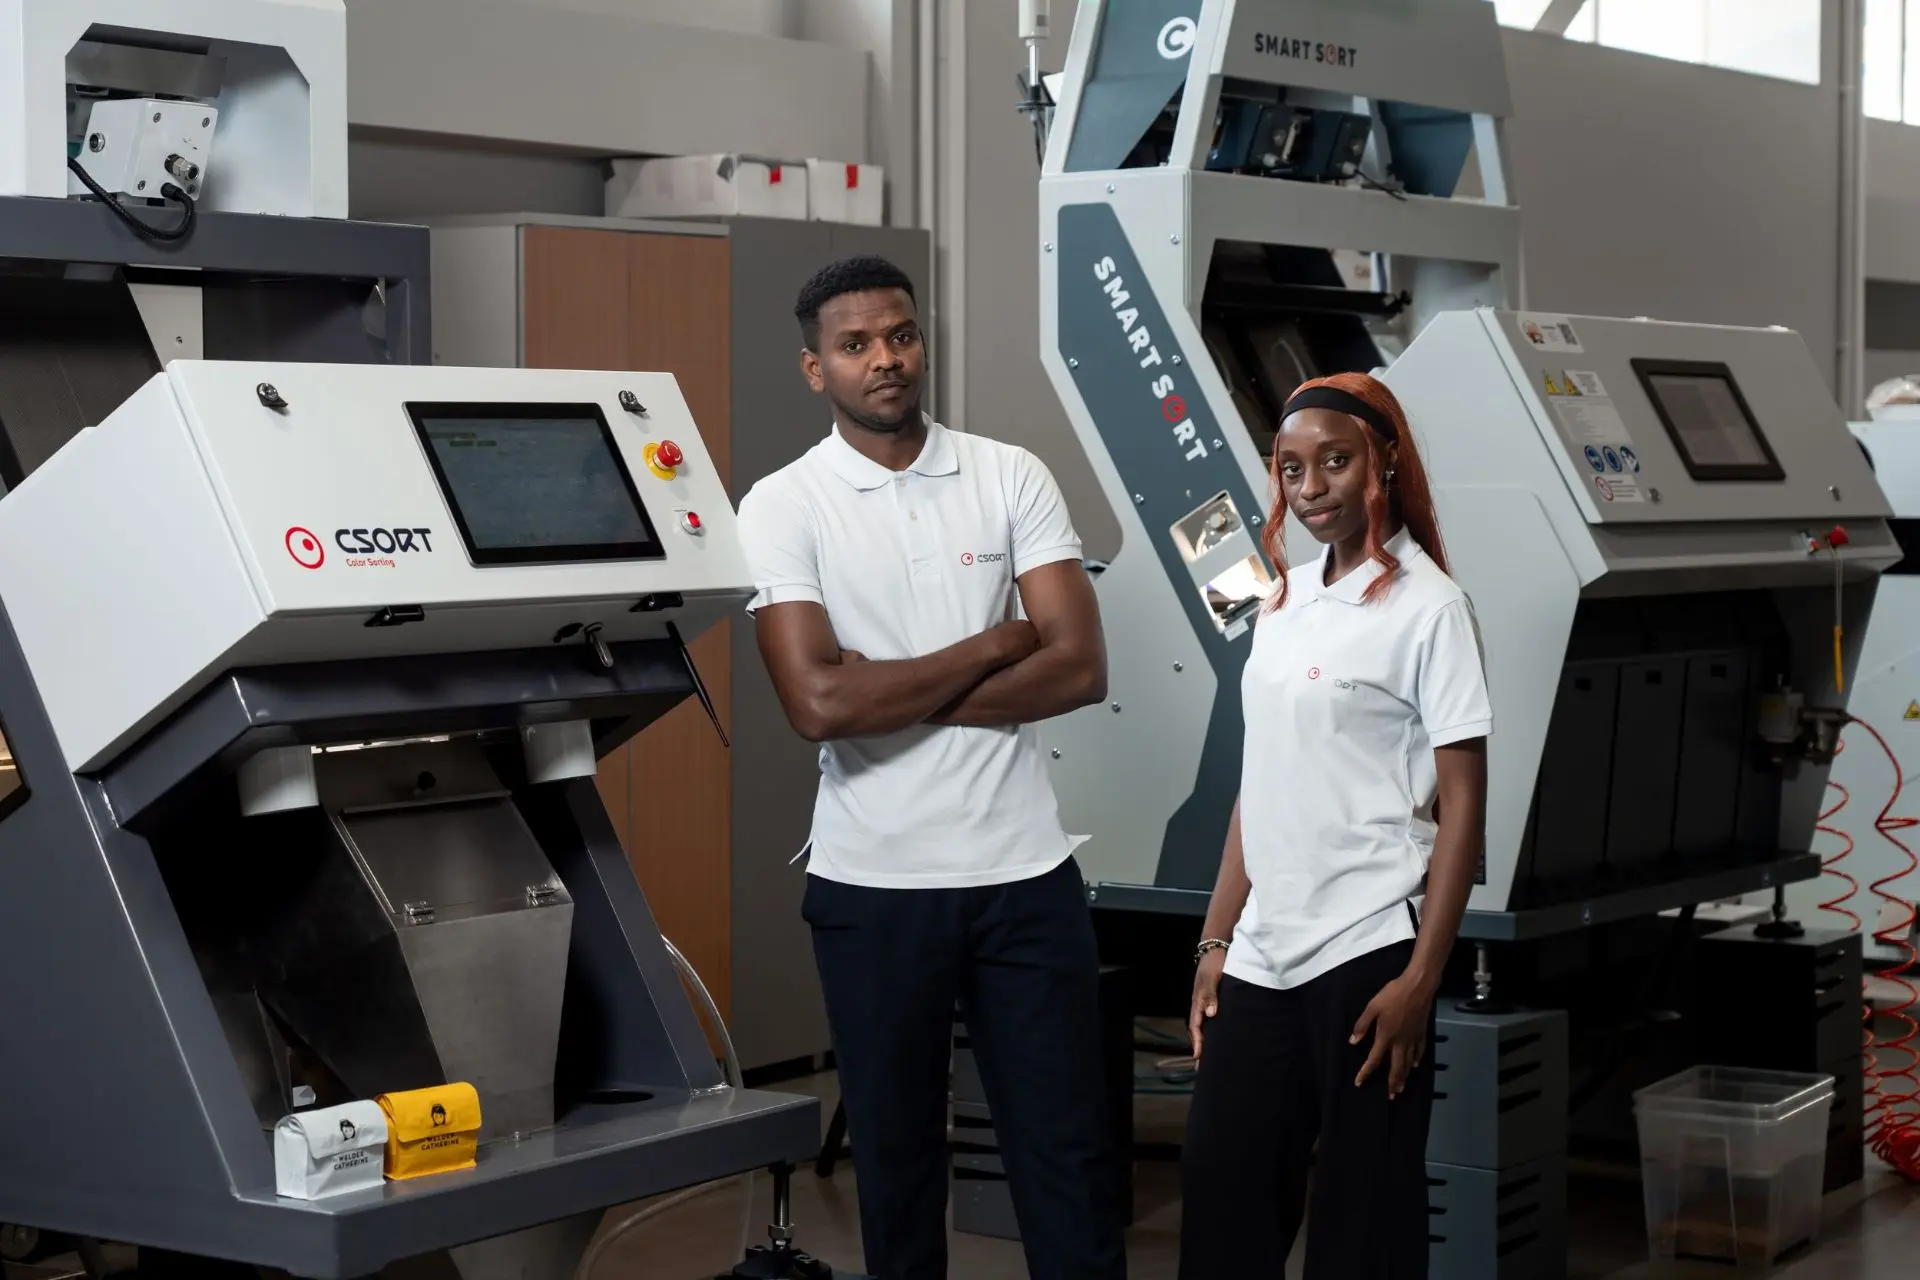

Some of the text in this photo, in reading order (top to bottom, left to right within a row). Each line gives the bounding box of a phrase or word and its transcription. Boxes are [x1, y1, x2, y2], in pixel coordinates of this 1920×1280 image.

[1254, 32, 1357, 68] SMART SORT
[1094, 256, 1208, 461] SMART SORT
[334, 527, 433, 554] CSORT
[346, 557, 396, 568] Color Sorting
[420, 1137, 460, 1150] CATHERINE
[333, 1156, 369, 1170] CATHERINE
